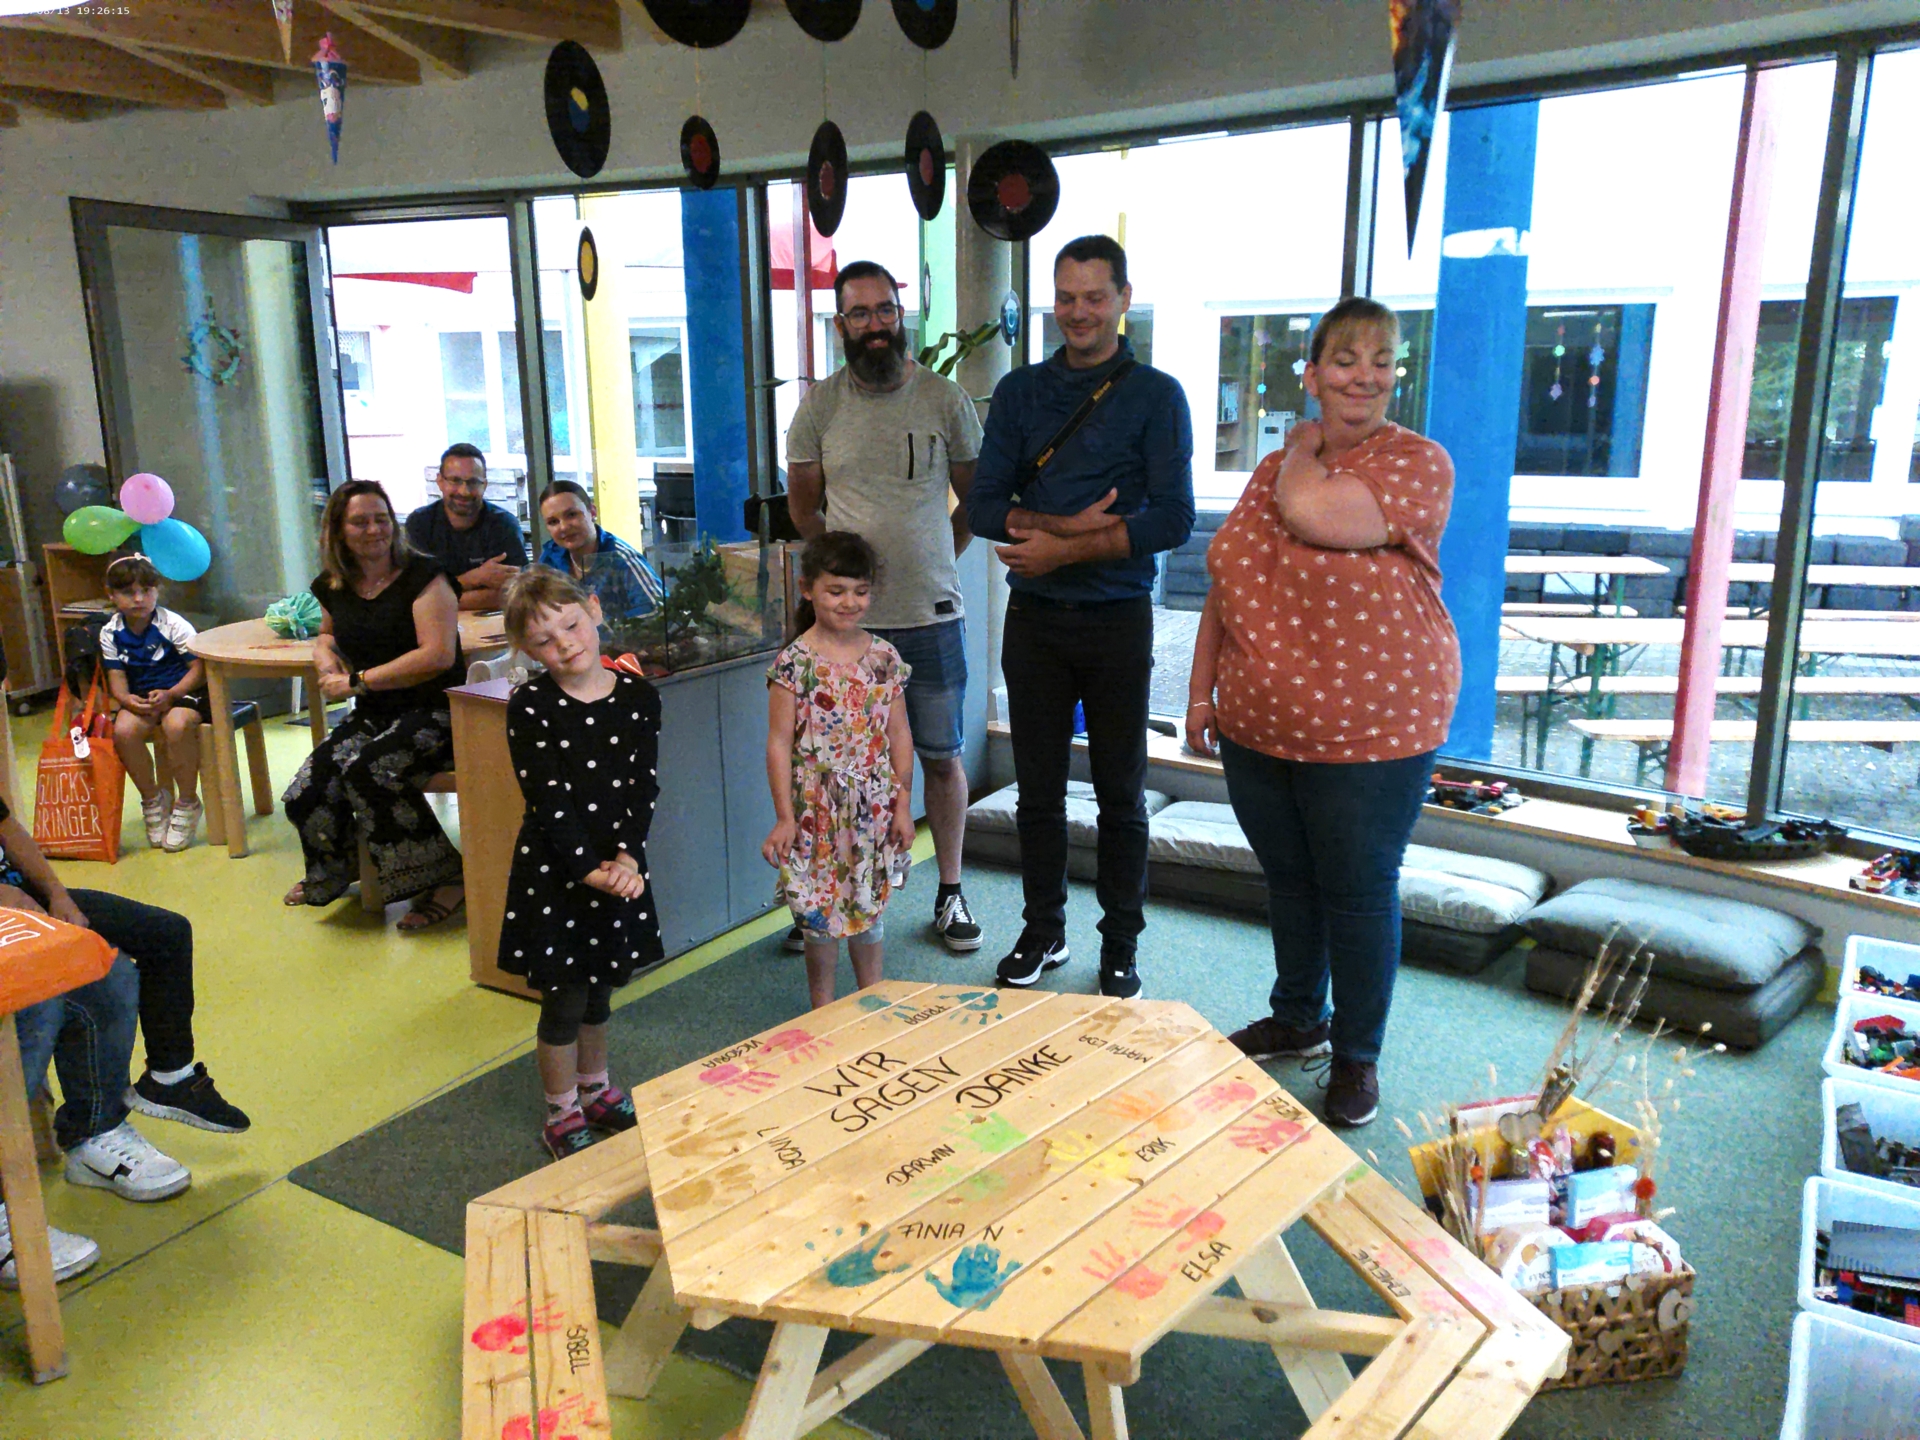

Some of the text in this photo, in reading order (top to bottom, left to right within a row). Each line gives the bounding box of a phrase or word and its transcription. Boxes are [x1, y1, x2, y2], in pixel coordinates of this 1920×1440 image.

[904, 1004, 948, 1026] FRIDA
[804, 1051, 907, 1098] WIR
[830, 1056, 962, 1133] SAGEN
[955, 1044, 1073, 1109] DANKE
[757, 1126, 807, 1170] LINDA
[886, 1144, 956, 1186] DARWIN
[1135, 1136, 1177, 1163] ERIK
[1180, 1241, 1232, 1283] ELSA
